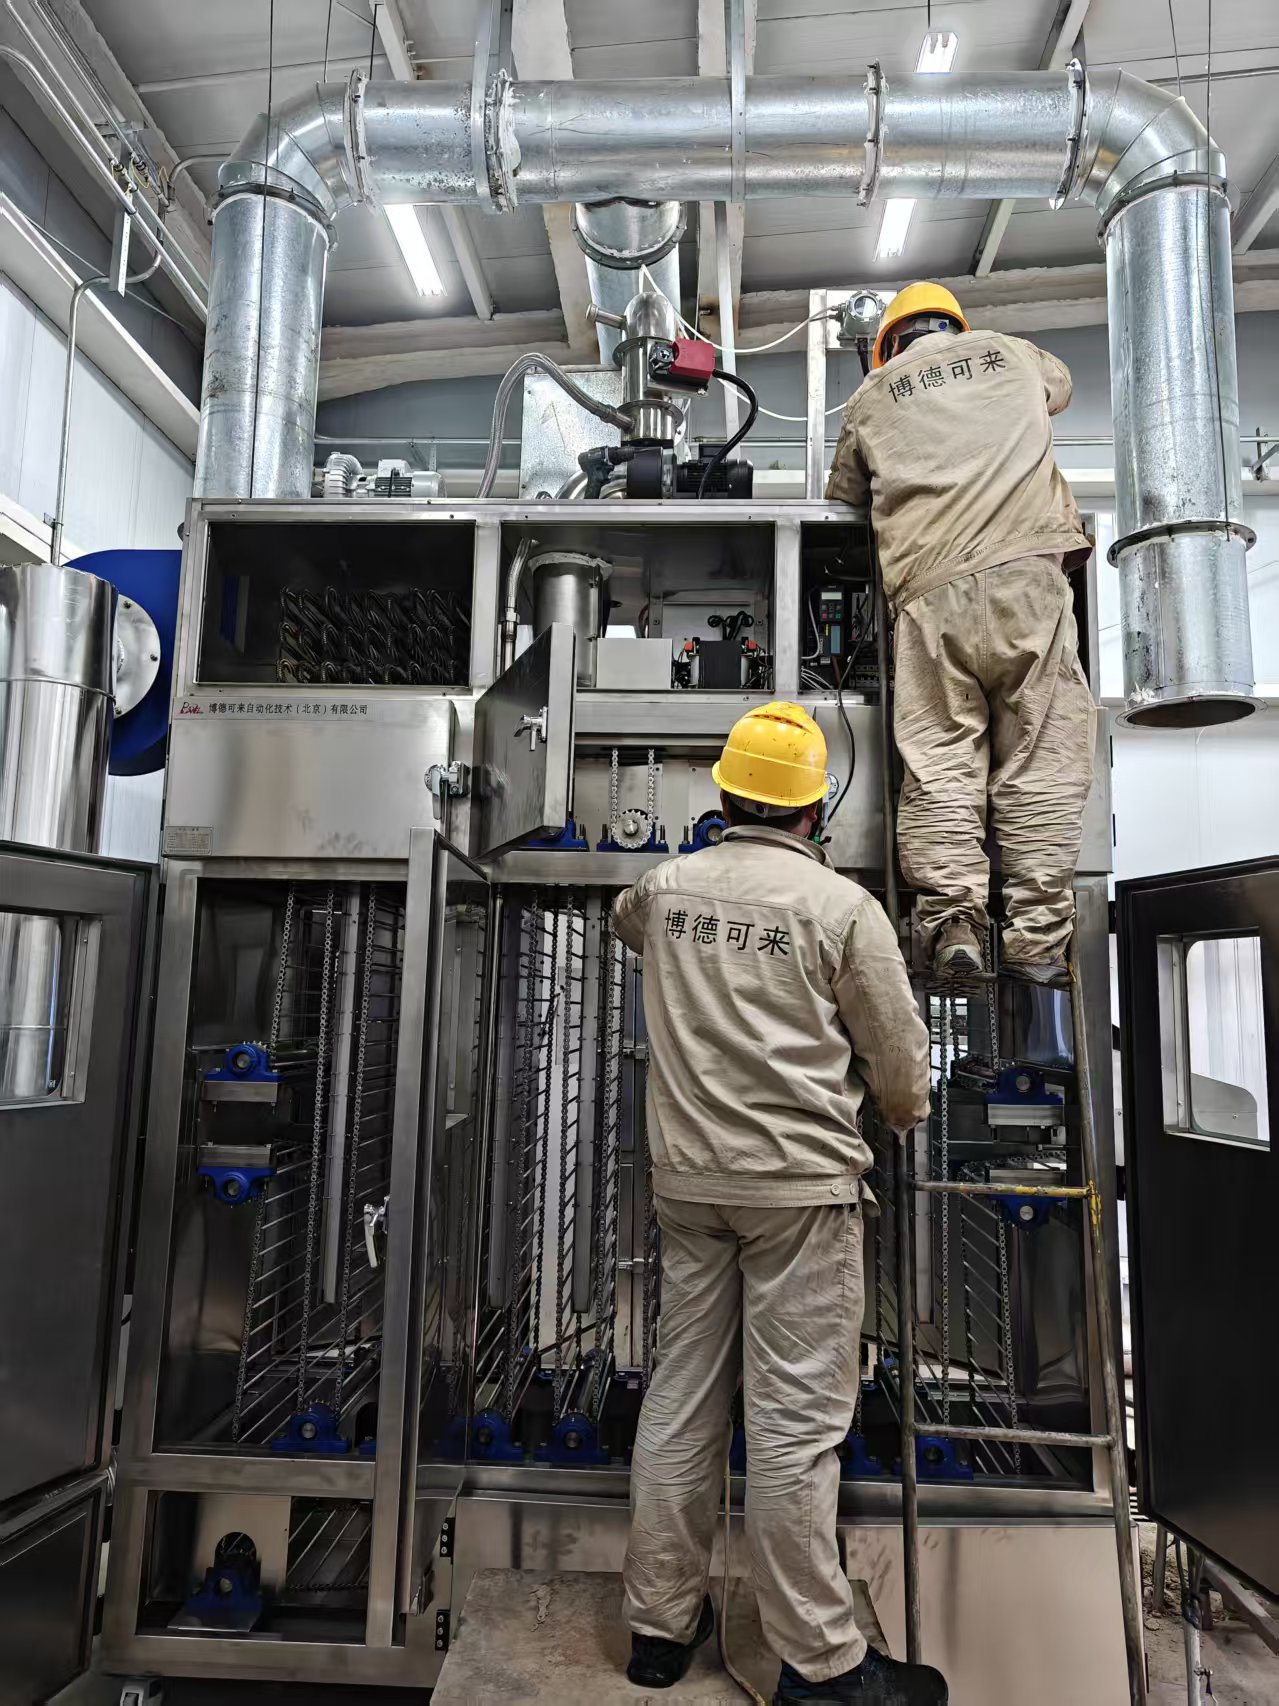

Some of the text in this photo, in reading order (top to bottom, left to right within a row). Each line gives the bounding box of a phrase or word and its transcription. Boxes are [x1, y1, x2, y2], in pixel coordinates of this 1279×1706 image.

[888, 350, 1006, 403] 博德可来
[665, 908, 790, 956] 博德可来
